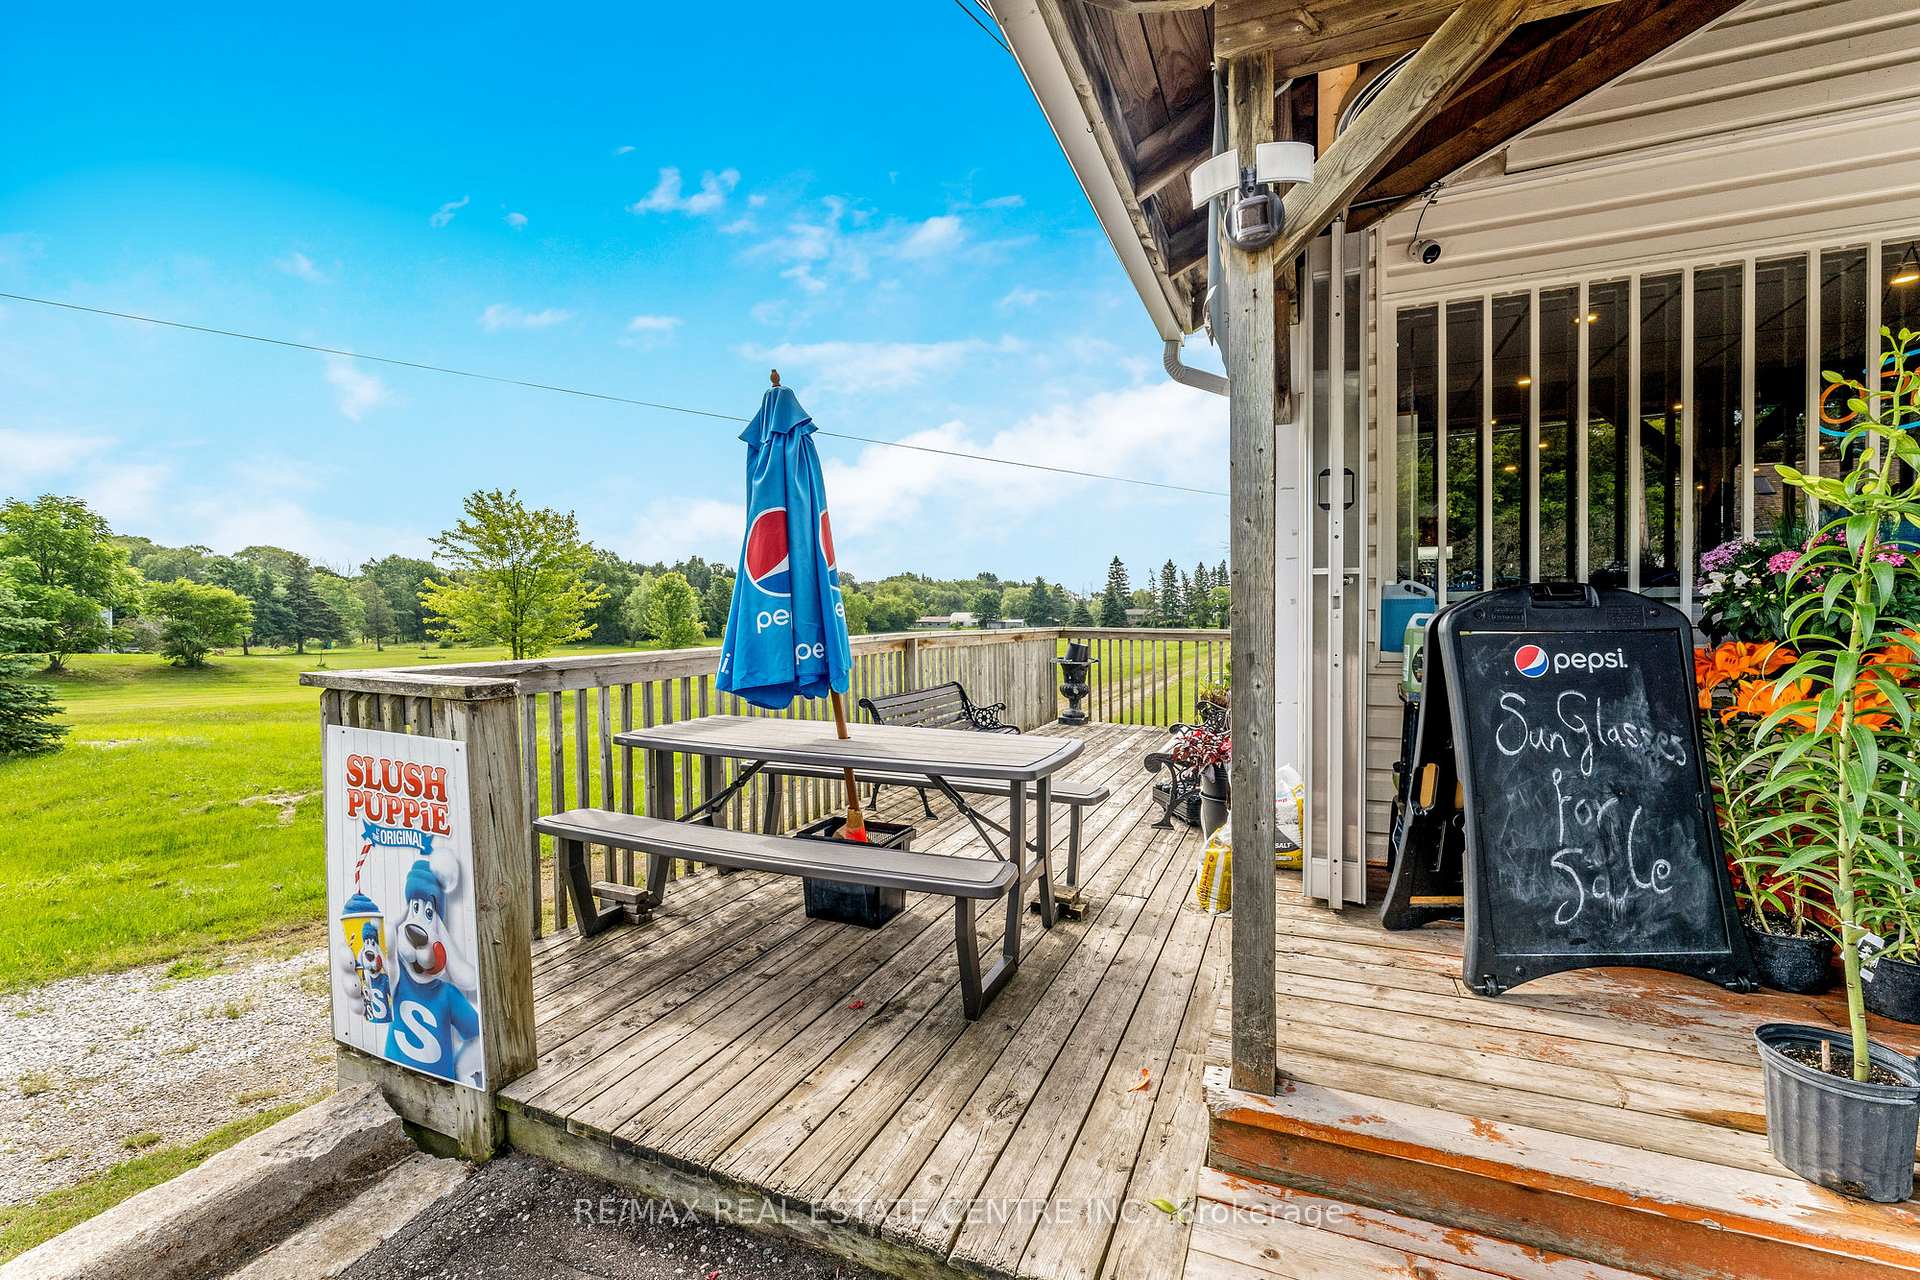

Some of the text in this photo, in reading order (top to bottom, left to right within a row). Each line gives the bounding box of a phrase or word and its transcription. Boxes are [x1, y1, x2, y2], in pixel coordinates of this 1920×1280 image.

[346, 753, 448, 803] SLUSH
[380, 829, 425, 850] ORIGINAL
[394, 1000, 442, 1064] S
